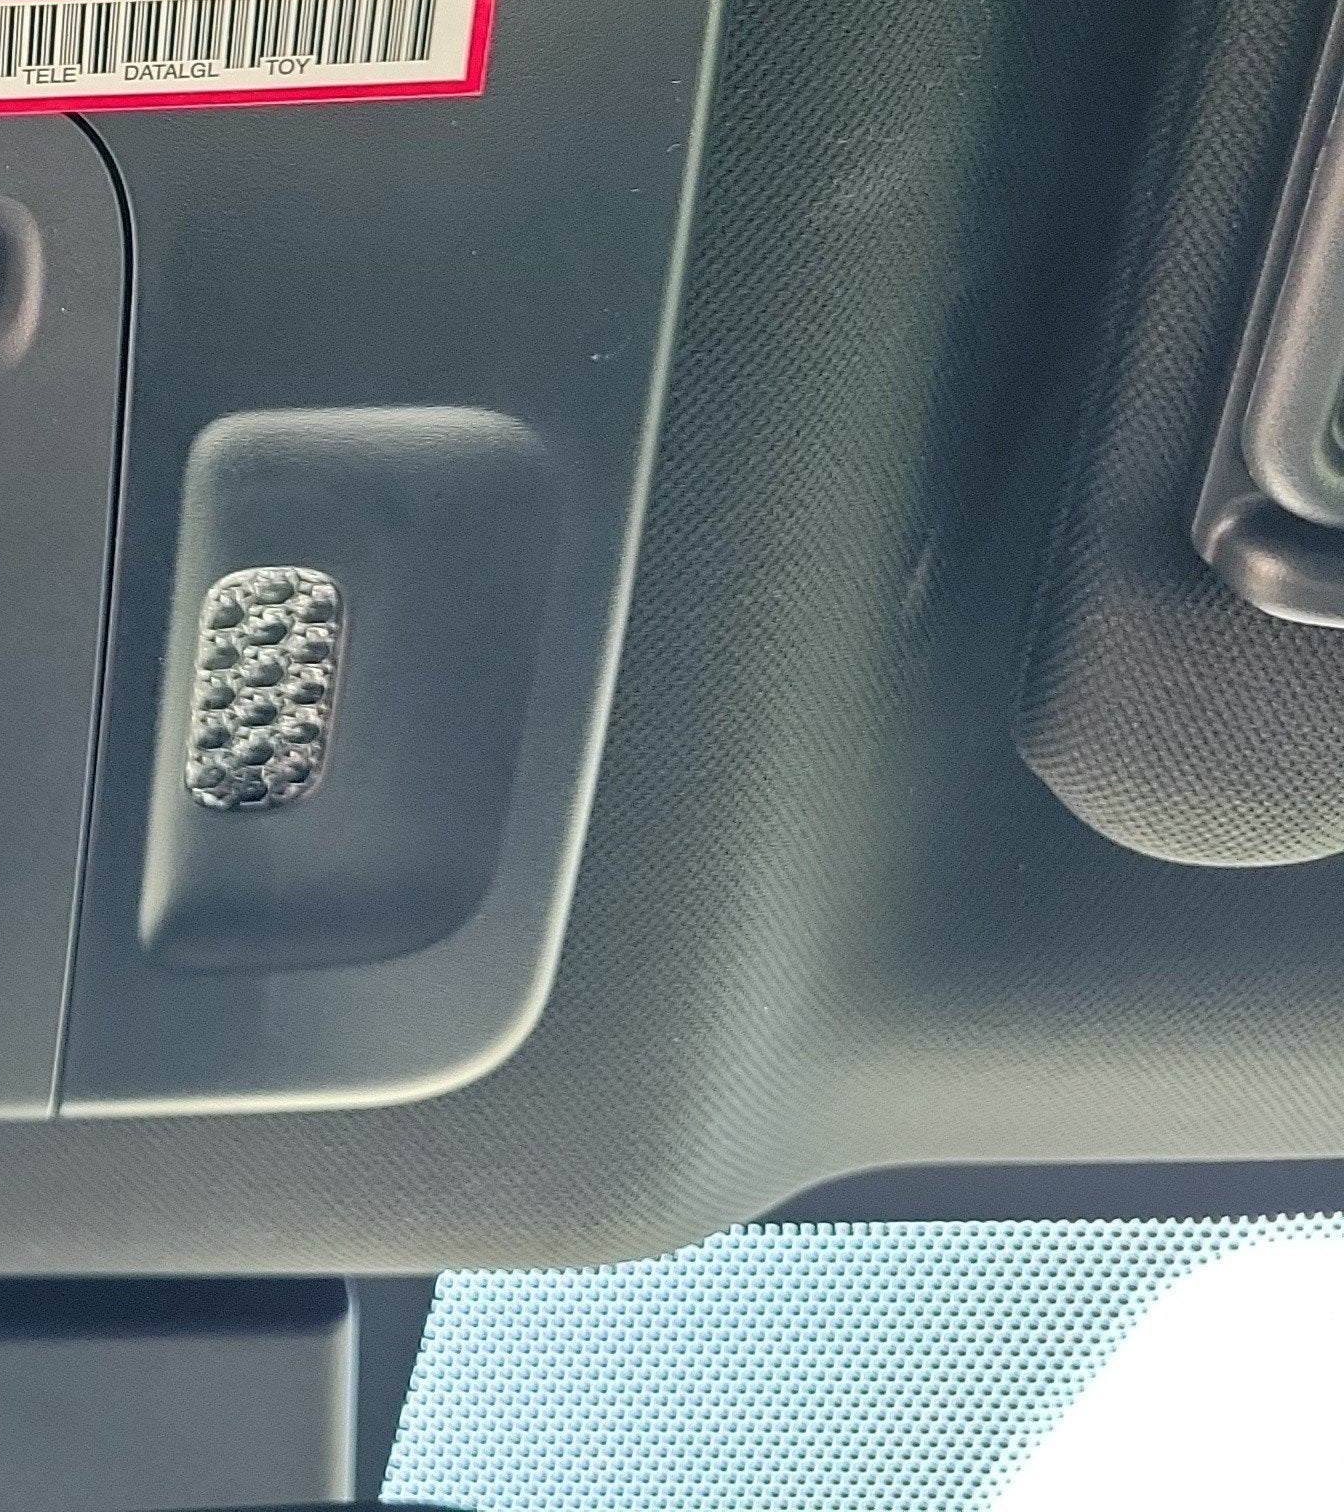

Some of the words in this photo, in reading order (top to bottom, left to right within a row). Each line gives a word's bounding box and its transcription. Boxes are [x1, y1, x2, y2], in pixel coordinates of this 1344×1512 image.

[23, 66, 78, 85] TELE
[124, 61, 220, 82] DATALGL
[266, 57, 312, 76] TOY
